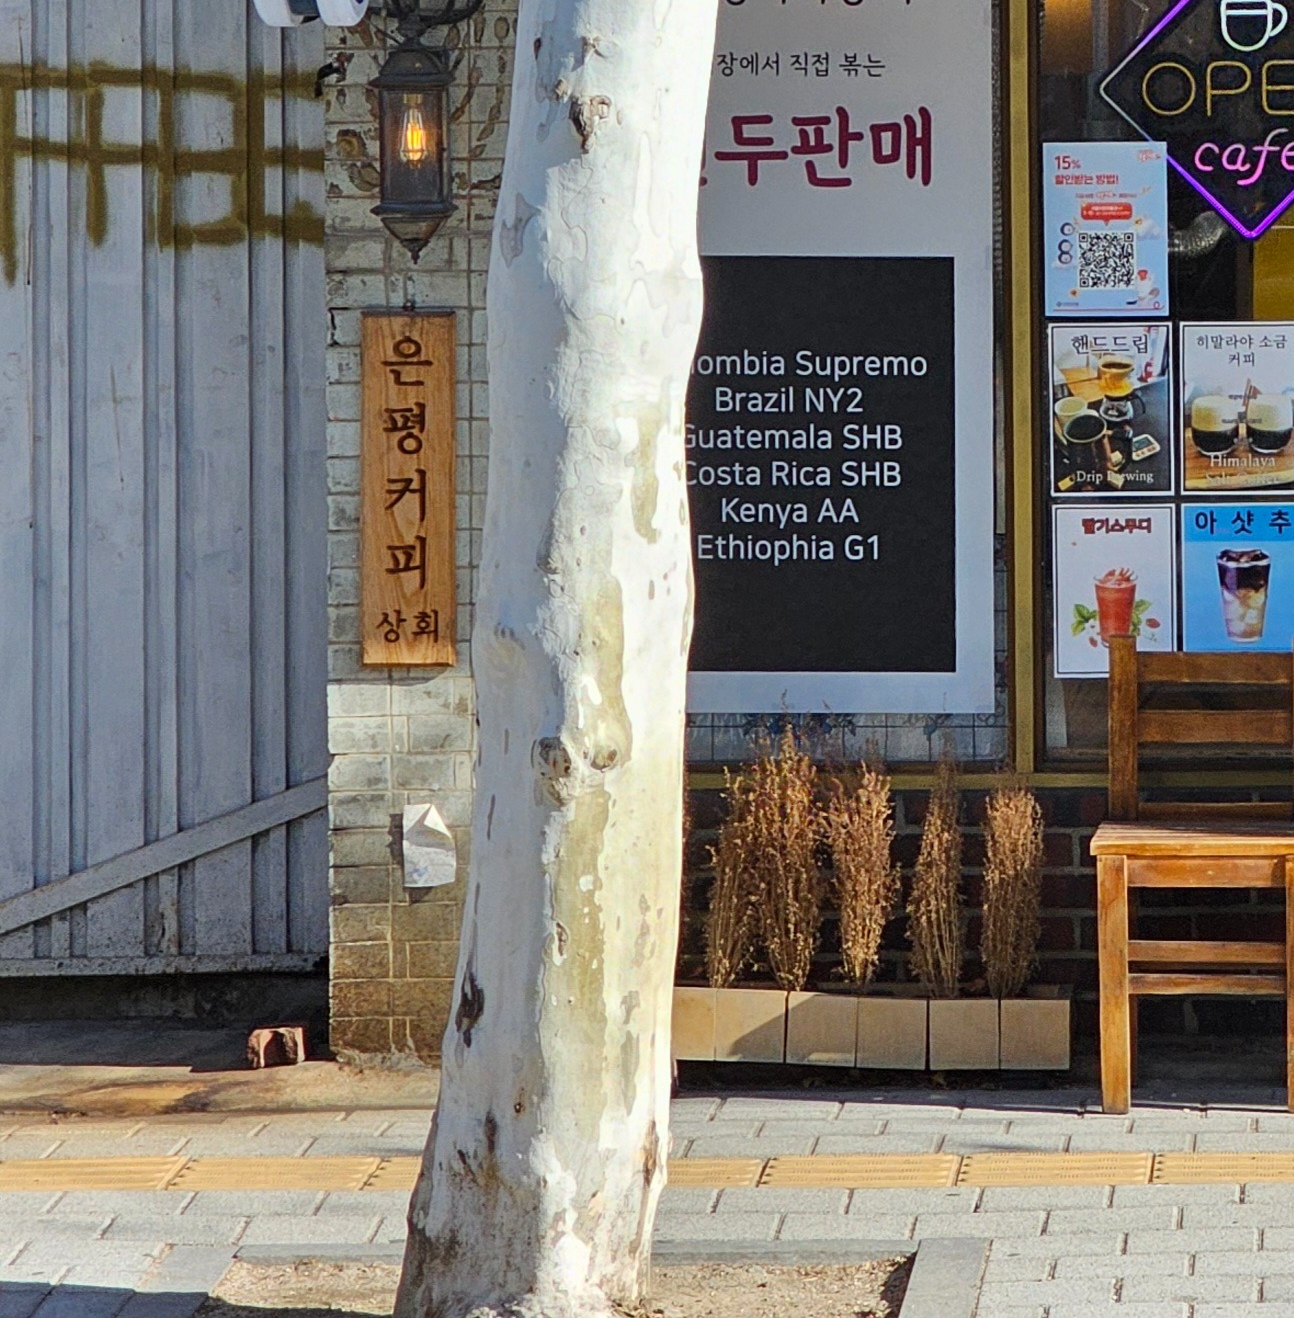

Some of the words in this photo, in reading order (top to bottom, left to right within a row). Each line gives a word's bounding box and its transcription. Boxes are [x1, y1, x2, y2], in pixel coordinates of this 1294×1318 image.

[716, 52, 780, 77] 장에서
[790, 52, 830, 77] 직접
[838, 53, 887, 78] 볶는
[700, 106, 932, 187] 두판매
[1054, 155, 1082, 170] 15%
[1071, 334, 1148, 355] 핸드드립
[1196, 334, 1254, 349] 히말라야
[1258, 334, 1288, 349] 소금
[795, 351, 928, 382] Supremo
[1228, 352, 1256, 367] 커피
[715, 386, 794, 413] Brazil
[804, 388, 863, 413] NY2
[842, 425, 903, 450] SHB
[380, 335, 434, 590] 은평커피
[771, 461, 831, 486] Rica
[841, 461, 902, 486] SHB
[1209, 453, 1276, 470] Himalaya
[1076, 470, 1103, 485] Drip
[1107, 470, 1154, 485] ewing
[721, 498, 808, 530] Kenya
[816, 498, 859, 523] AA
[1082, 517, 1152, 534] 딸기스무디
[697, 534, 834, 566] Ethiophia
[844, 534, 880, 560] G1
[375, 608, 440, 645] 상회
